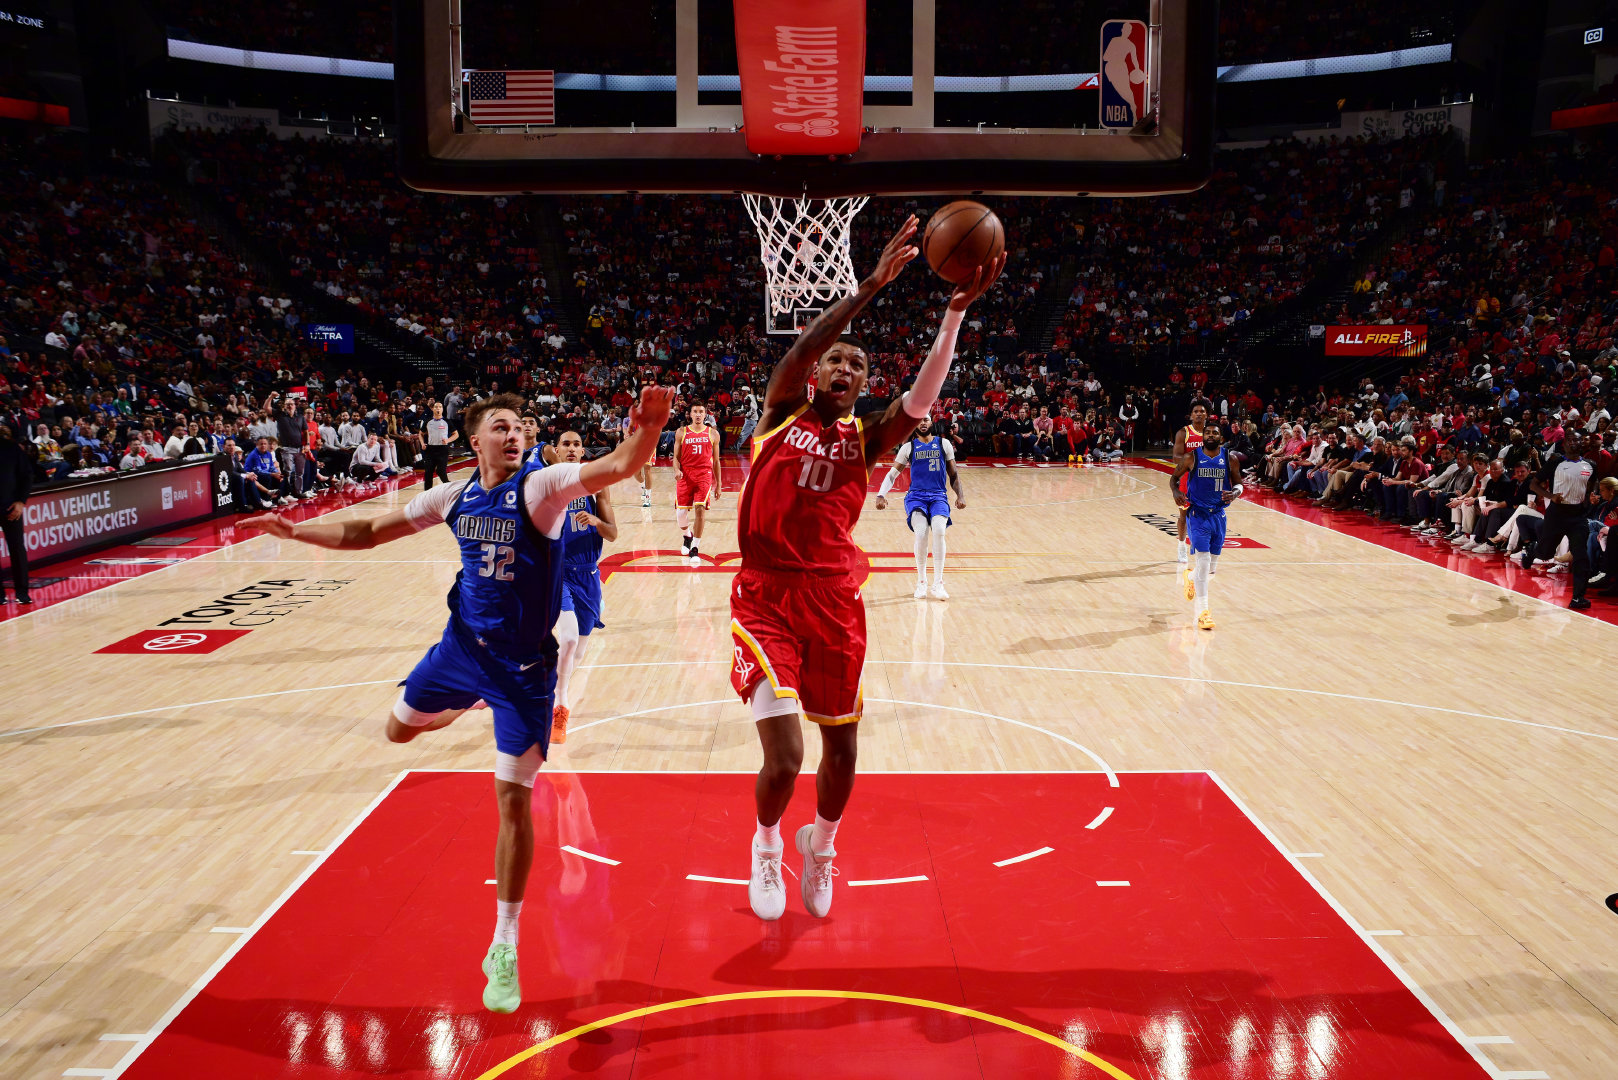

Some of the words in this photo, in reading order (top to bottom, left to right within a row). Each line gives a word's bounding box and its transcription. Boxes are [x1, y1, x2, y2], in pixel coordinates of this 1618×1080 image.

[16, 15, 45, 29] ZONE
[1106, 105, 1128, 122] NBA
[310, 332, 343, 340] ULTRA
[692, 444, 702, 454] 31
[784, 425, 859, 460] ROCKETS
[797, 454, 834, 491] 10
[929, 459, 941, 472] 21
[173, 489, 188, 502] RAV4
[1215, 478, 1224, 491] 11
[60, 490, 111, 517] VEHICLE
[217, 492, 233, 507] Frost
[86, 507, 138, 536] ROCKETS
[457, 514, 516, 543] DALLAS
[479, 542, 514, 581] 32
[157, 578, 306, 627] TOYOTA
[229, 578, 357, 627] CENTER
